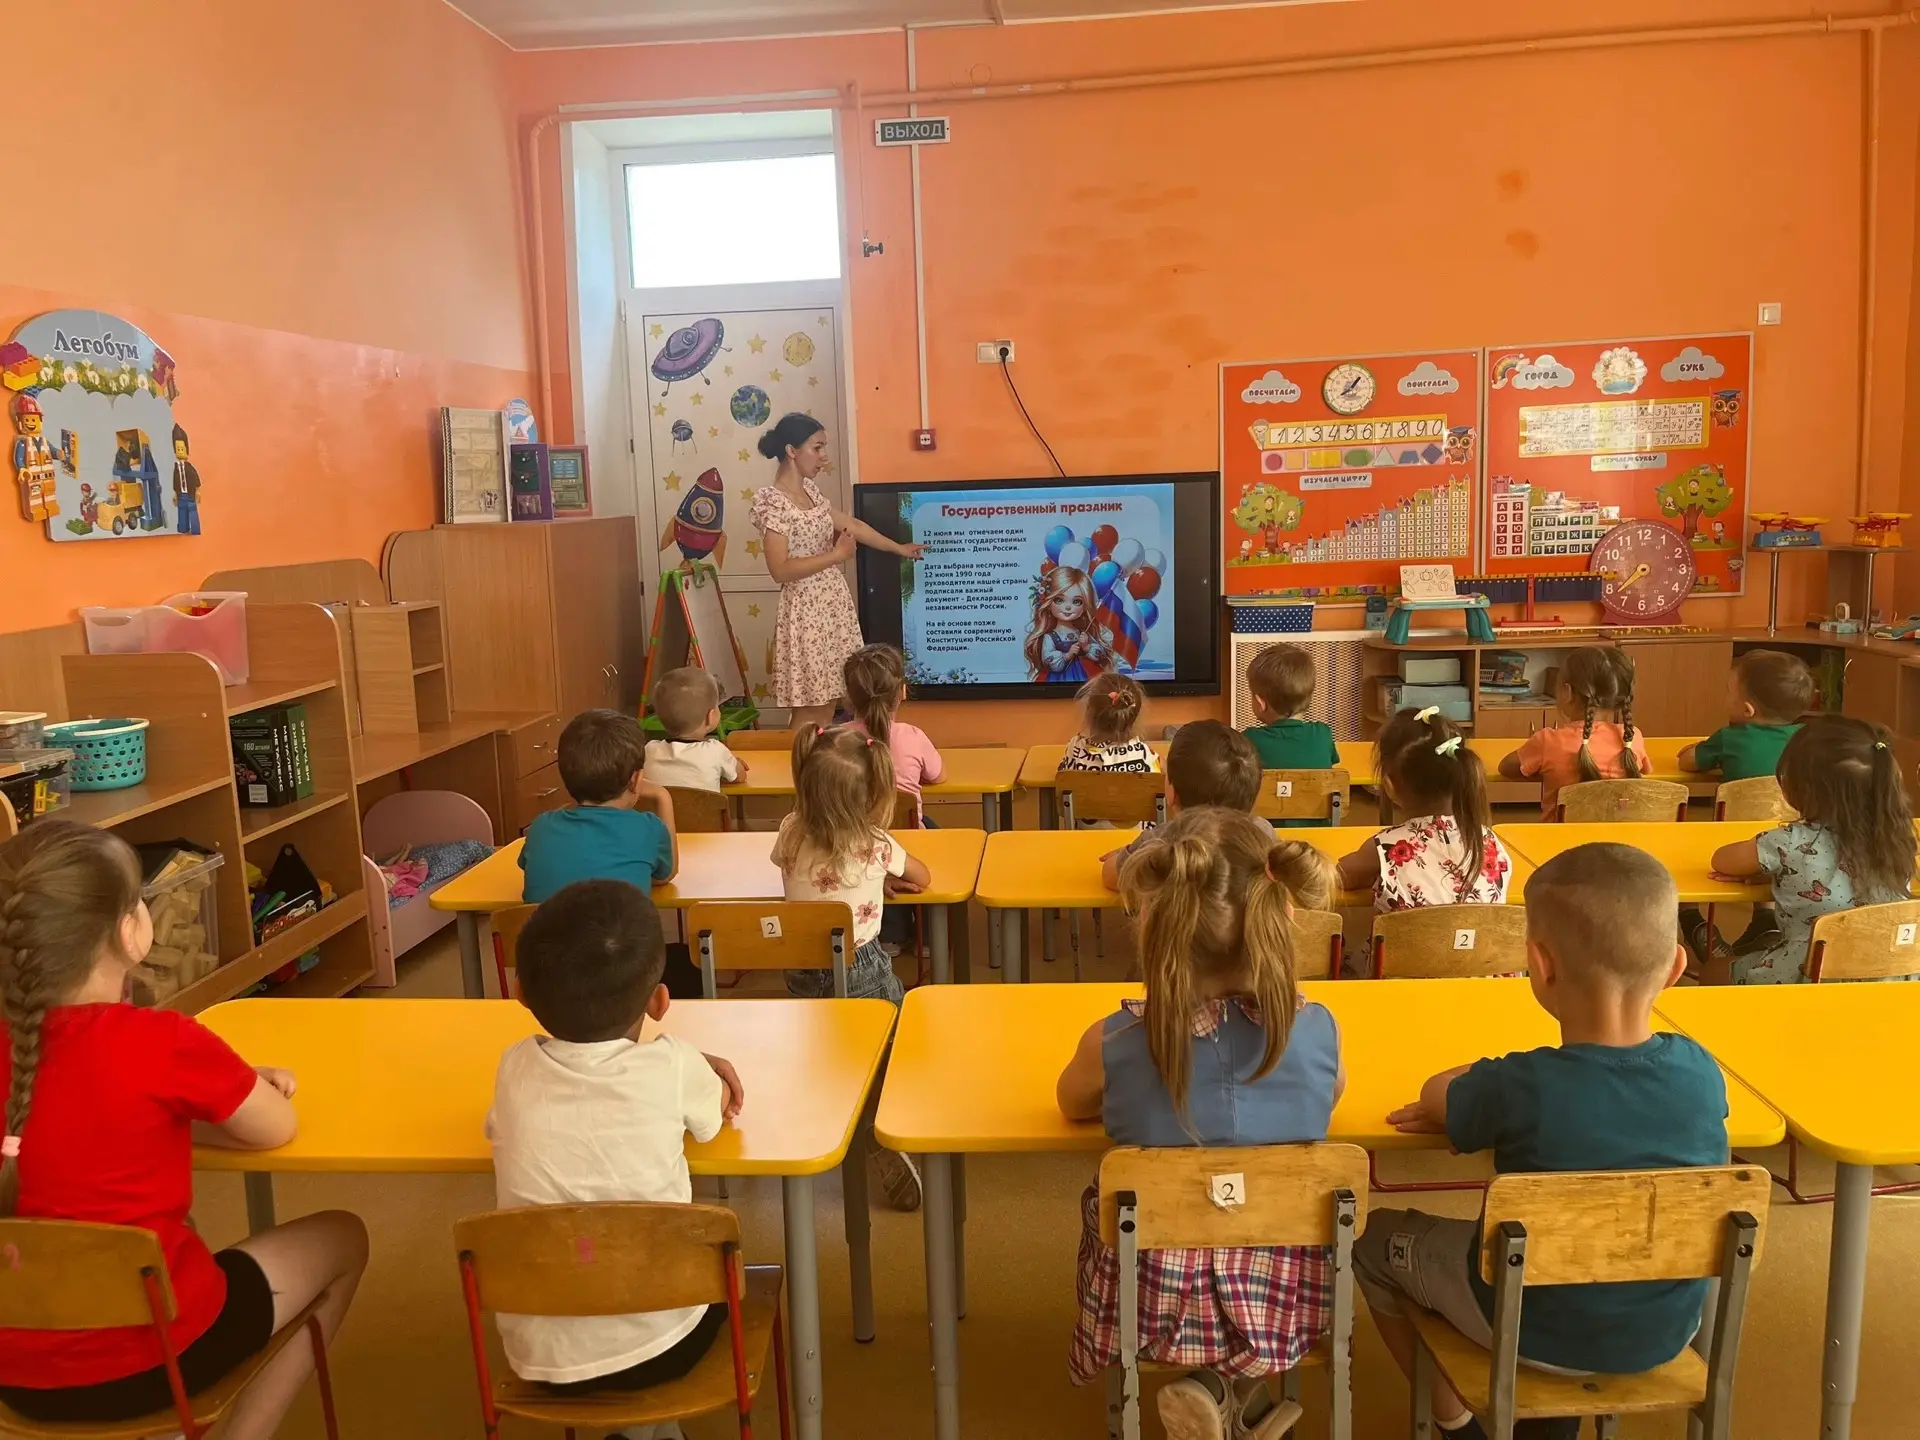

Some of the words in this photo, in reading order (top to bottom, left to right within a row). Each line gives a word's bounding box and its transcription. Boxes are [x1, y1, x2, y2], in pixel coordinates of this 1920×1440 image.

[884, 124, 943, 139] ВЫХОД
[54, 329, 140, 362] Легобум
[1525, 371, 1558, 380] ГОРОД
[1406, 380, 1449, 388] ПОИГРАЕМ
[1304, 476, 1339, 484] ИЗУЧАЕМ
[941, 502, 1057, 519] Государственный
[1060, 501, 1123, 516] праздник
[1514, 502, 1521, 510] Я
[1498, 514, 1506, 522] О
[954, 529, 965, 537] мы
[1006, 528, 1024, 536] один
[1499, 525, 1505, 533] У
[1637, 529, 1652, 540] 12
[964, 536, 1027, 546] государственных
[1617, 535, 1631, 546] 11
[1660, 534, 1666, 545] 1
[923, 546, 966, 555] праздников
[992, 544, 1020, 552] России.
[1604, 549, 1620, 560] 10
[1674, 547, 1682, 558] 2
[943, 562, 974, 570] выбрана
[975, 562, 1020, 570] неслучайно.
[1678, 563, 1687, 574] 3
[924, 579, 975, 587] руководители
[1002, 578, 1028, 586] страны
[1671, 582, 1679, 592] 4
[965, 586, 993, 594] важный
[1605, 583, 1613, 594] 8
[925, 596, 960, 604] документ
[966, 595, 1012, 603] Декларацию
[1620, 595, 1627, 606] 7
[1637, 599, 1646, 611] 6
[1657, 595, 1665, 606] 5
[925, 603, 978, 611] независимости
[937, 619, 945, 627] её
[963, 627, 1012, 636] современную
[926, 636, 974, 644] Конституцию
[975, 635, 1016, 643] Российской
[243, 742, 254, 751] 160
[300, 719, 310, 781] МЕТАЛЕКС
[283, 725, 294, 788] МЕТАЛЕКС
[291, 722, 302, 785] МЕТАЛЕКС
[273, 728, 284, 792] МЕТАЛЕКС
[1104, 762, 1142, 772] Video
[1280, 785, 1288, 795] 2
[766, 922, 776, 935] 2
[1459, 934, 1469, 946] 2
[1901, 928, 1910, 941] 2
[1222, 1182, 1236, 1201] 2
